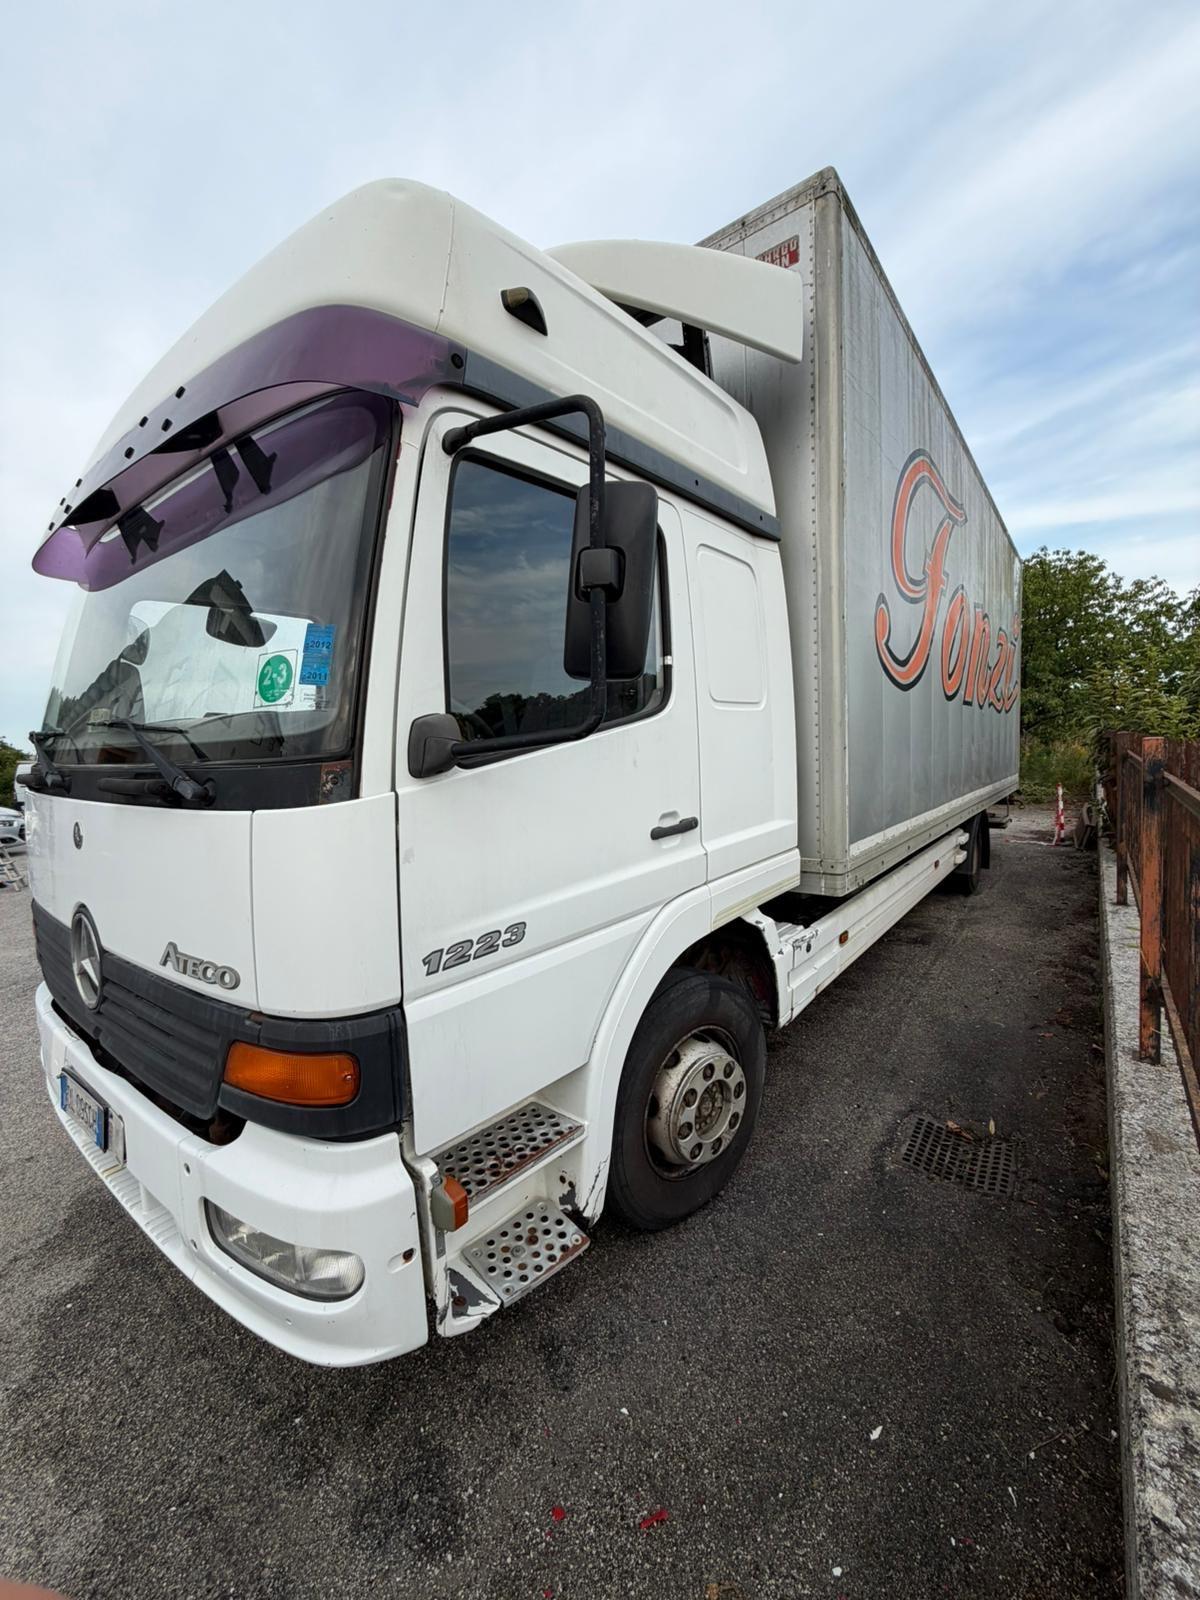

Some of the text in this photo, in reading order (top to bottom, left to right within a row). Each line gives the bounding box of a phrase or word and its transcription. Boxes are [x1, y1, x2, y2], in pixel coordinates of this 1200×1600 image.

[309, 640, 332, 650] 2012
[306, 671, 328, 681] 2011
[421, 921, 527, 977] 1223
